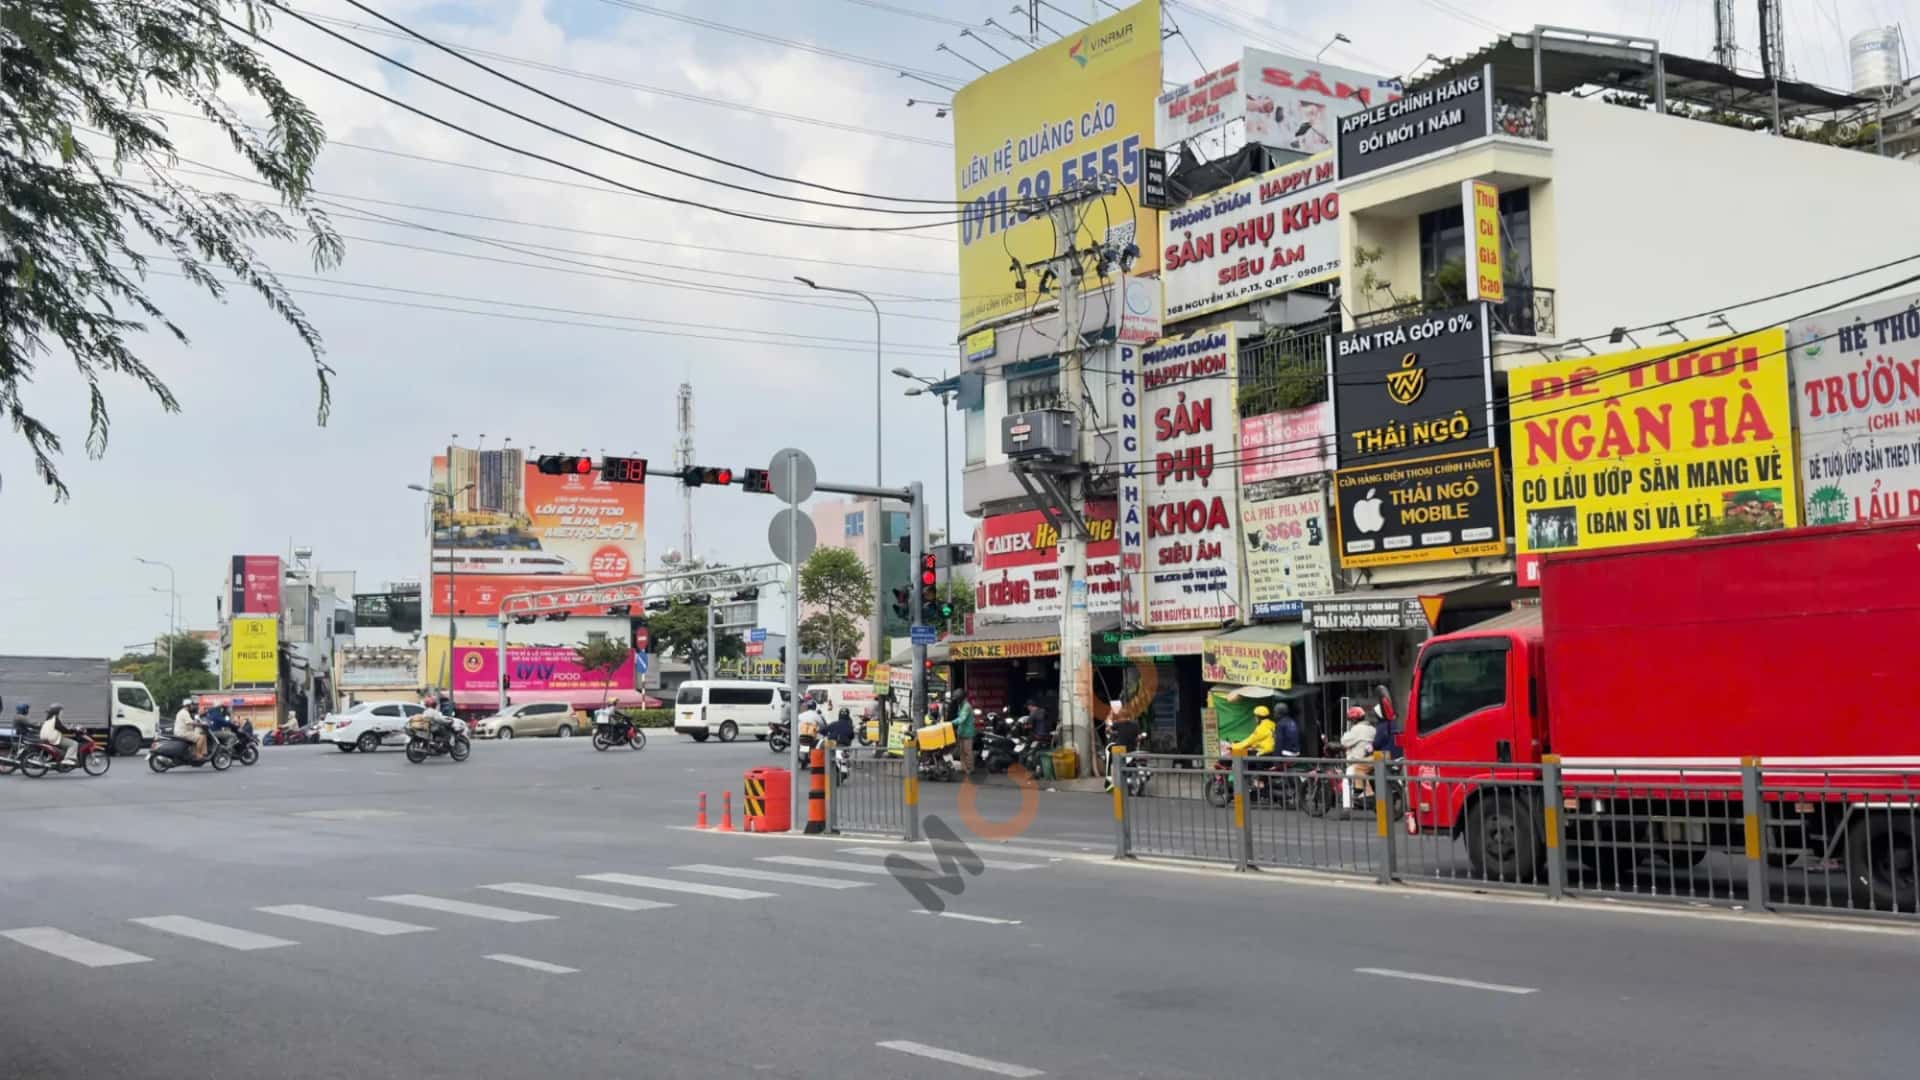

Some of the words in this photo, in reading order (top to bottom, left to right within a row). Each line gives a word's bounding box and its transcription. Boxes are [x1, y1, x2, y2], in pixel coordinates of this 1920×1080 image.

[1342, 107, 1385, 134] APPLE
[1389, 90, 1433, 117] CHÍNH
[1359, 130, 1383, 154] ĐỔI
[1386, 122, 1414, 145] MỚI
[1418, 123, 1425, 135] 1
[1428, 109, 1462, 131] NĂM
[961, 155, 988, 190] LIÊN
[994, 139, 1012, 175] HỆ
[1018, 119, 1074, 162] QUẢNG
[1081, 102, 1115, 137] CÁO
[1170, 205, 1212, 231] PHÒNG
[1214, 192, 1252, 217] KHÁM
[1260, 168, 1313, 201] HAPPY
[1476, 189, 1495, 208] Thu
[1165, 230, 1214, 271] SẢN
[1221, 213, 1275, 253] PHỤ
[1479, 247, 1497, 265] Giá
[1218, 256, 1265, 285] SIÊU
[1271, 244, 1305, 272] ÂM
[1479, 275, 1500, 294] Cao
[1143, 343, 1186, 366] PHÒNG
[1187, 334, 1226, 355] KHÁM
[1339, 332, 1370, 356] BÁN
[1373, 326, 1406, 349] TRẢ
[1409, 319, 1444, 341] GÓP
[1448, 314, 1473, 334] 0%
[1838, 316, 1868, 358] HỆ
[1144, 360, 1189, 388] HAPPY
[1191, 353, 1226, 377] MOM
[1531, 366, 1600, 402] DÊ
[1628, 346, 1759, 388] TƯƠI
[1155, 391, 1212, 442] SẢN
[1352, 420, 1407, 454] THÁI
[1413, 409, 1470, 445] NGÔ
[1524, 399, 1673, 466] NGÂN
[1690, 378, 1774, 448] HÀ
[1868, 412, 1899, 432] (CHI
[1156, 444, 1214, 487] PHỤ
[1522, 475, 1547, 503] CÓ
[1687, 458, 1749, 488] MANG
[1756, 446, 1783, 480] VỀ
[1884, 444, 1910, 469] THEO
[1389, 482, 1432, 506] THÁI
[1437, 476, 1480, 497] NGÔ
[1147, 496, 1230, 539] KHOA
[1401, 502, 1470, 526] MOBILE
[1657, 503, 1680, 529] VÀ
[985, 531, 1033, 555] CALTEX
[1158, 541, 1192, 566] SIÊU
[1196, 539, 1222, 562] ÂM
[1340, 611, 1361, 627] NGÔ
[1363, 614, 1400, 627] MOBILE
[987, 645, 1001, 656] XE
[1004, 641, 1043, 656] HONDA
